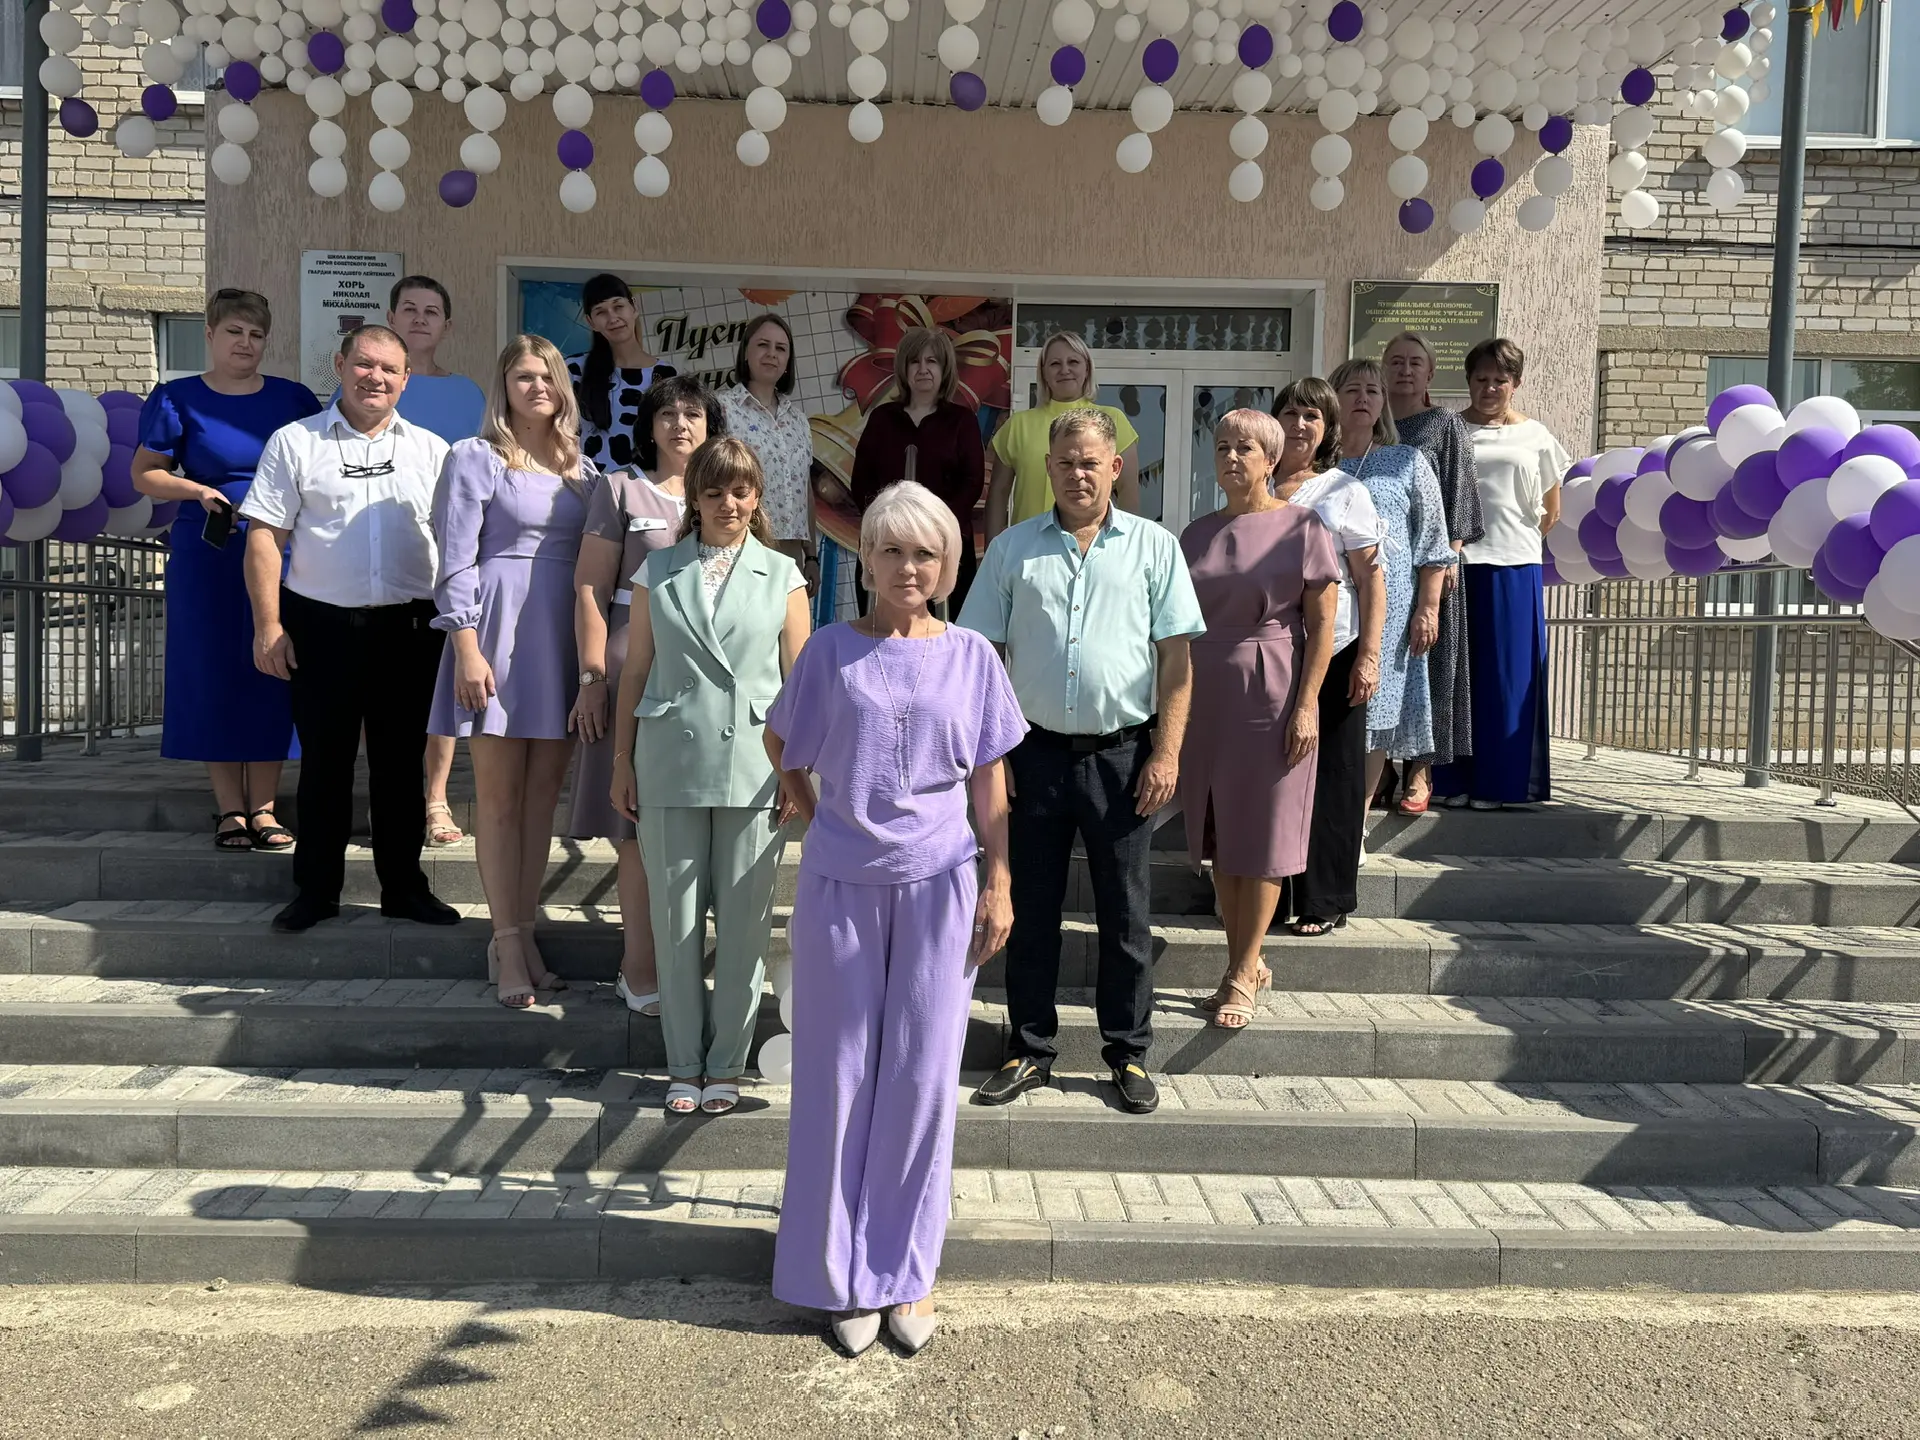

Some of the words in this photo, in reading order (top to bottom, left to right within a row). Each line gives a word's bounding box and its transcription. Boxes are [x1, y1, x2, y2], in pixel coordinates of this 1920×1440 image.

[338, 280, 365, 289] ХОРЬ
[332, 290, 370, 298] НИКОЛАЯ
[322, 299, 380, 309] МИХАЙЛОВИЧА
[656, 315, 747, 360] Пуст
